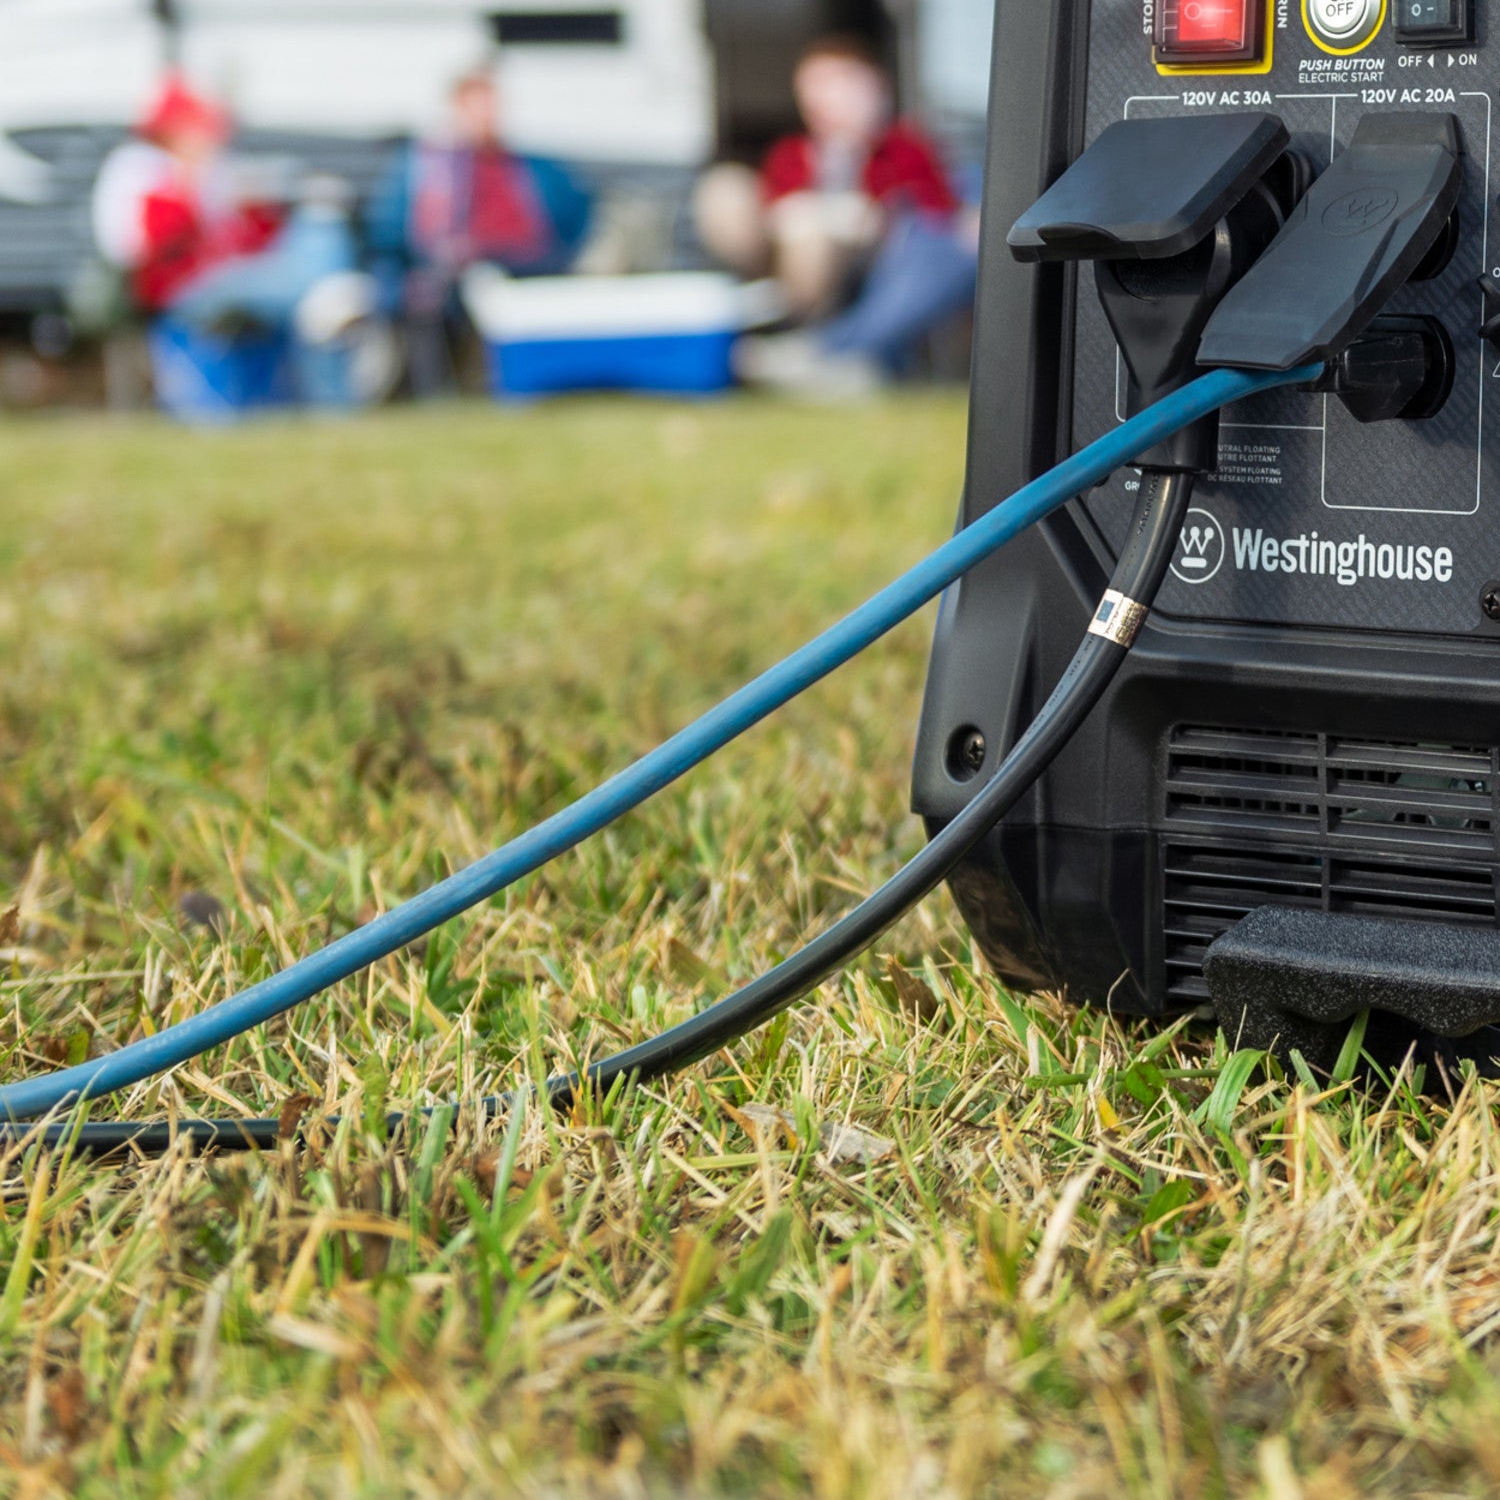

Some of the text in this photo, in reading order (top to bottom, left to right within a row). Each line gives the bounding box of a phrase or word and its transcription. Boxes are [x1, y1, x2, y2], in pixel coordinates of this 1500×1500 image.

[1325, 1, 1354, 17] OFF
[1299, 58, 1385, 71] PUSH BUTTON
[1398, 54, 1477, 68] OFF ON
[1298, 71, 1384, 83] ELECTRIC START
[1182, 91, 1272, 106] 120V AC 30A
[1361, 88, 1456, 103] 120V AC 20A
[1218, 444, 1242, 453] UTRAL
[1217, 453, 1237, 461] UTRE
[1232, 528, 1453, 585] Westinghouse
